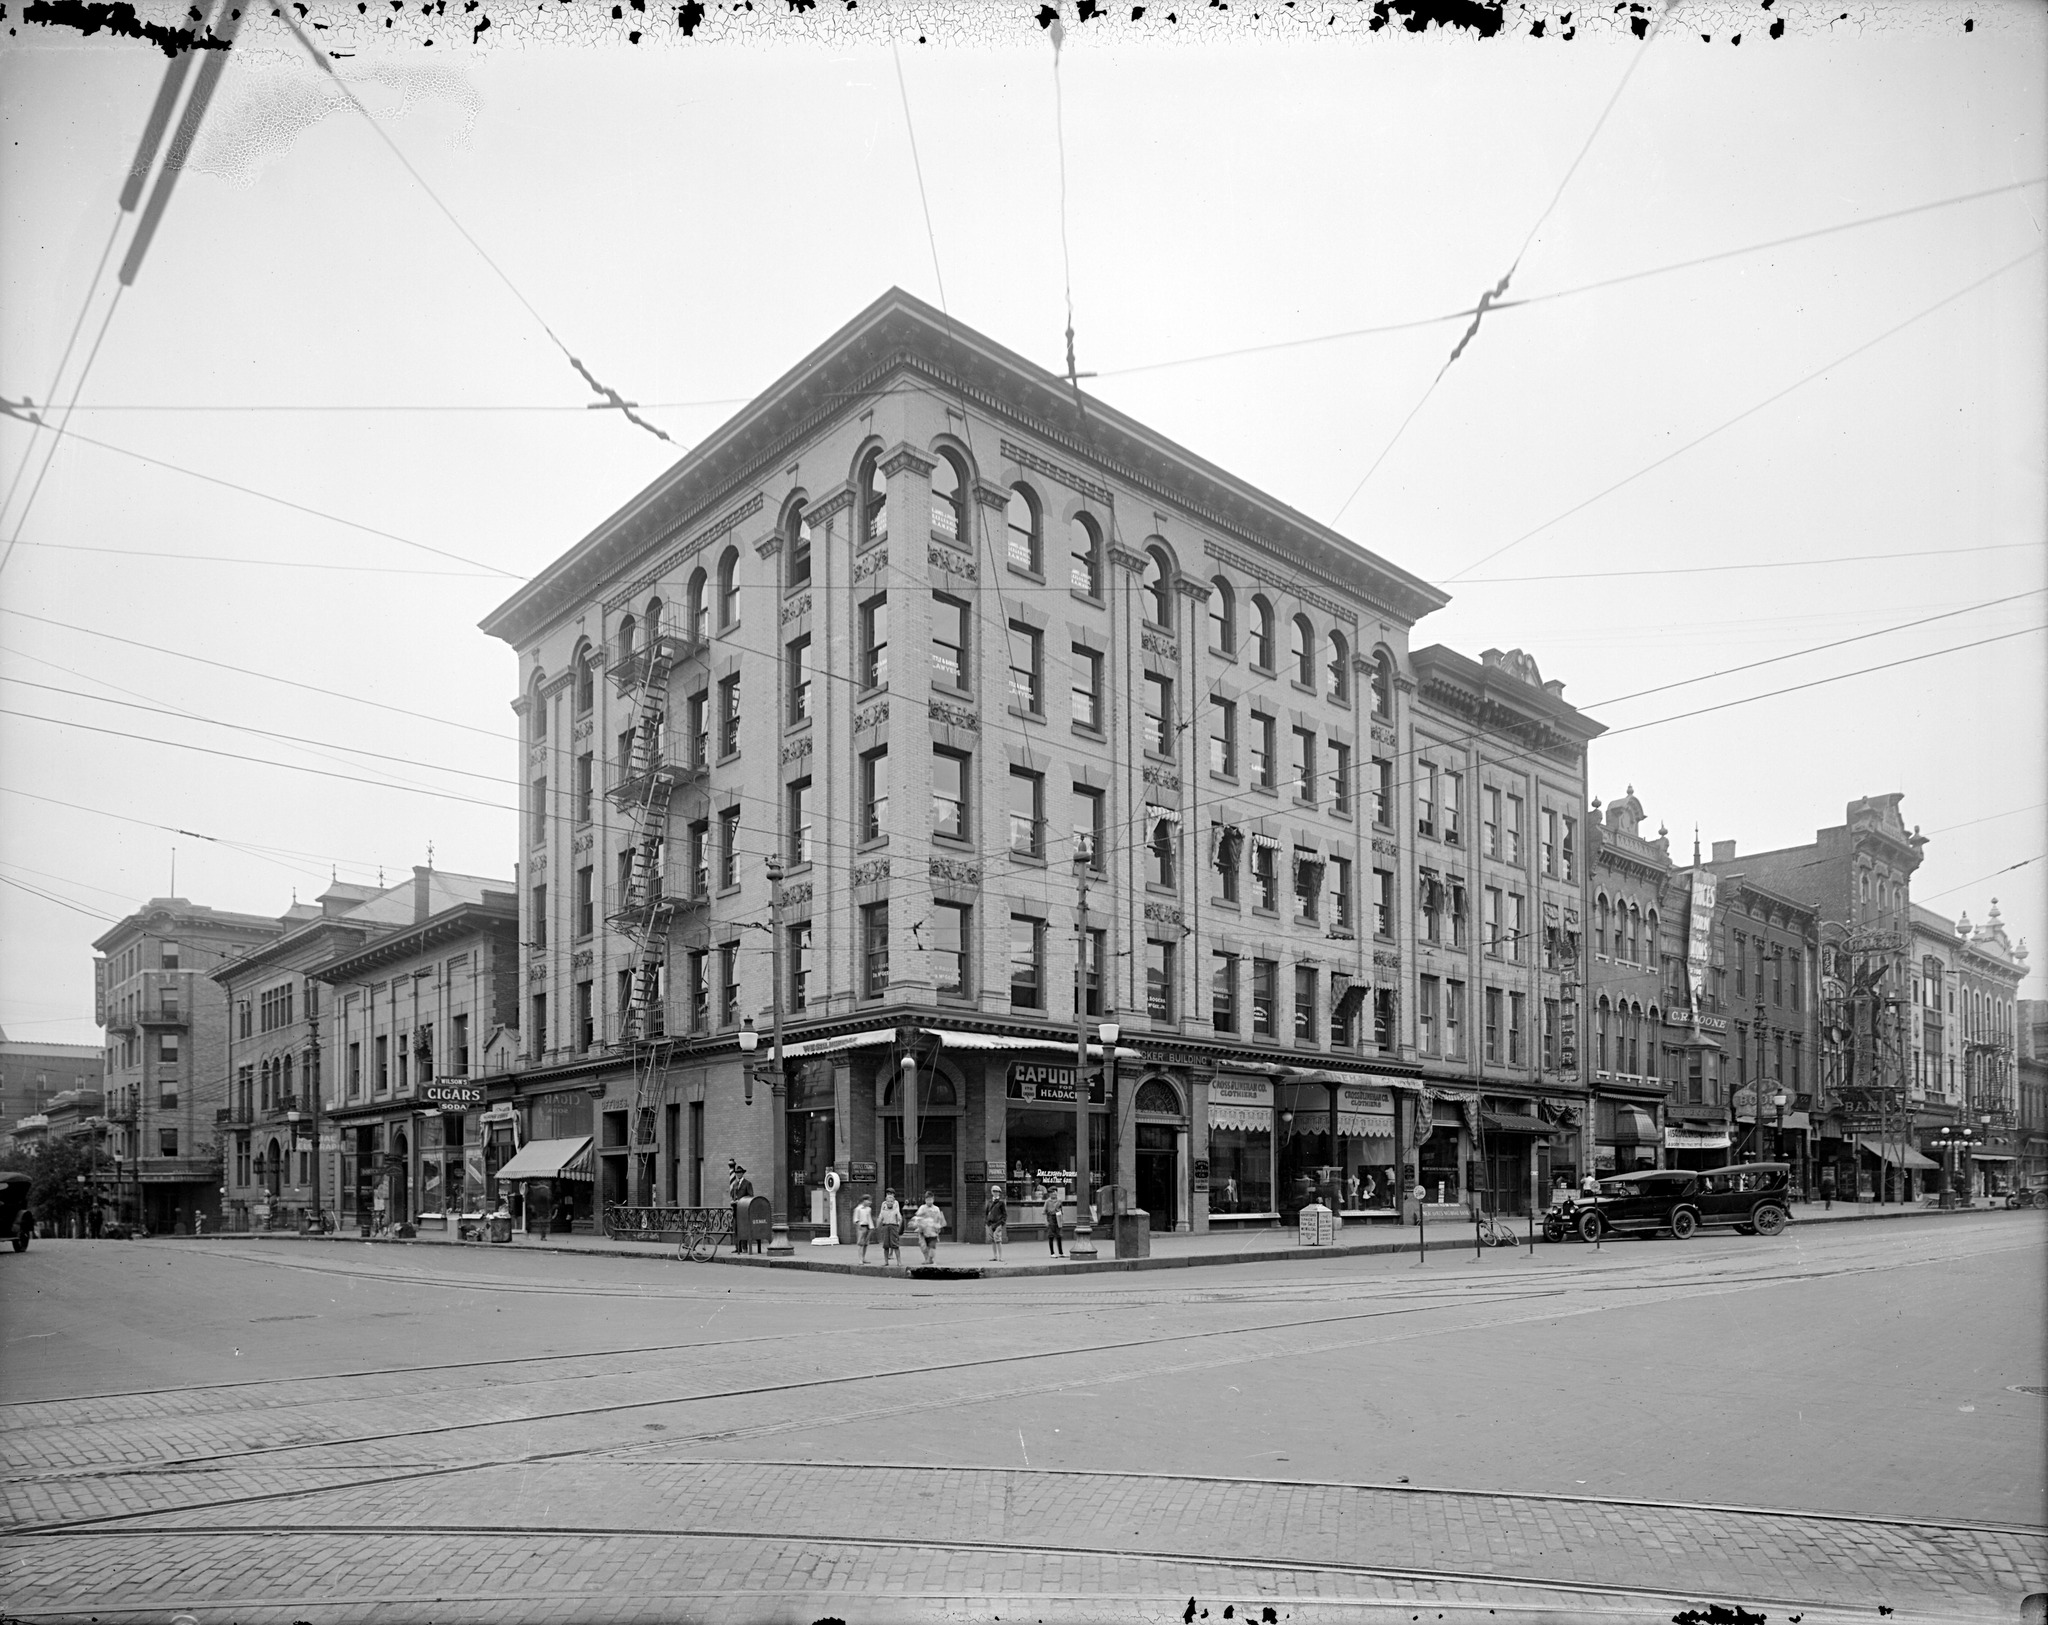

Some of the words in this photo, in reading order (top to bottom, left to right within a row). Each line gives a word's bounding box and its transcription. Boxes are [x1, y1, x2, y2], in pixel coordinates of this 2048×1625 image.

[1561, 970, 1573, 1065] TAILOR
[1699, 1015, 1727, 1029] OONE
[1142, 1051, 1163, 1061] CKER
[1169, 1053, 1207, 1065] BUILDING
[1015, 1065, 1095, 1087] CAPUDIE
[427, 1088, 480, 1101] CIGARS
[1041, 1089, 1091, 1100] HEADACS
[1220, 1090, 1257, 1099] CLOTHIERS
[1351, 1100, 1381, 1108] CLOTHIERS
[1844, 1101, 1891, 1112] BANK
